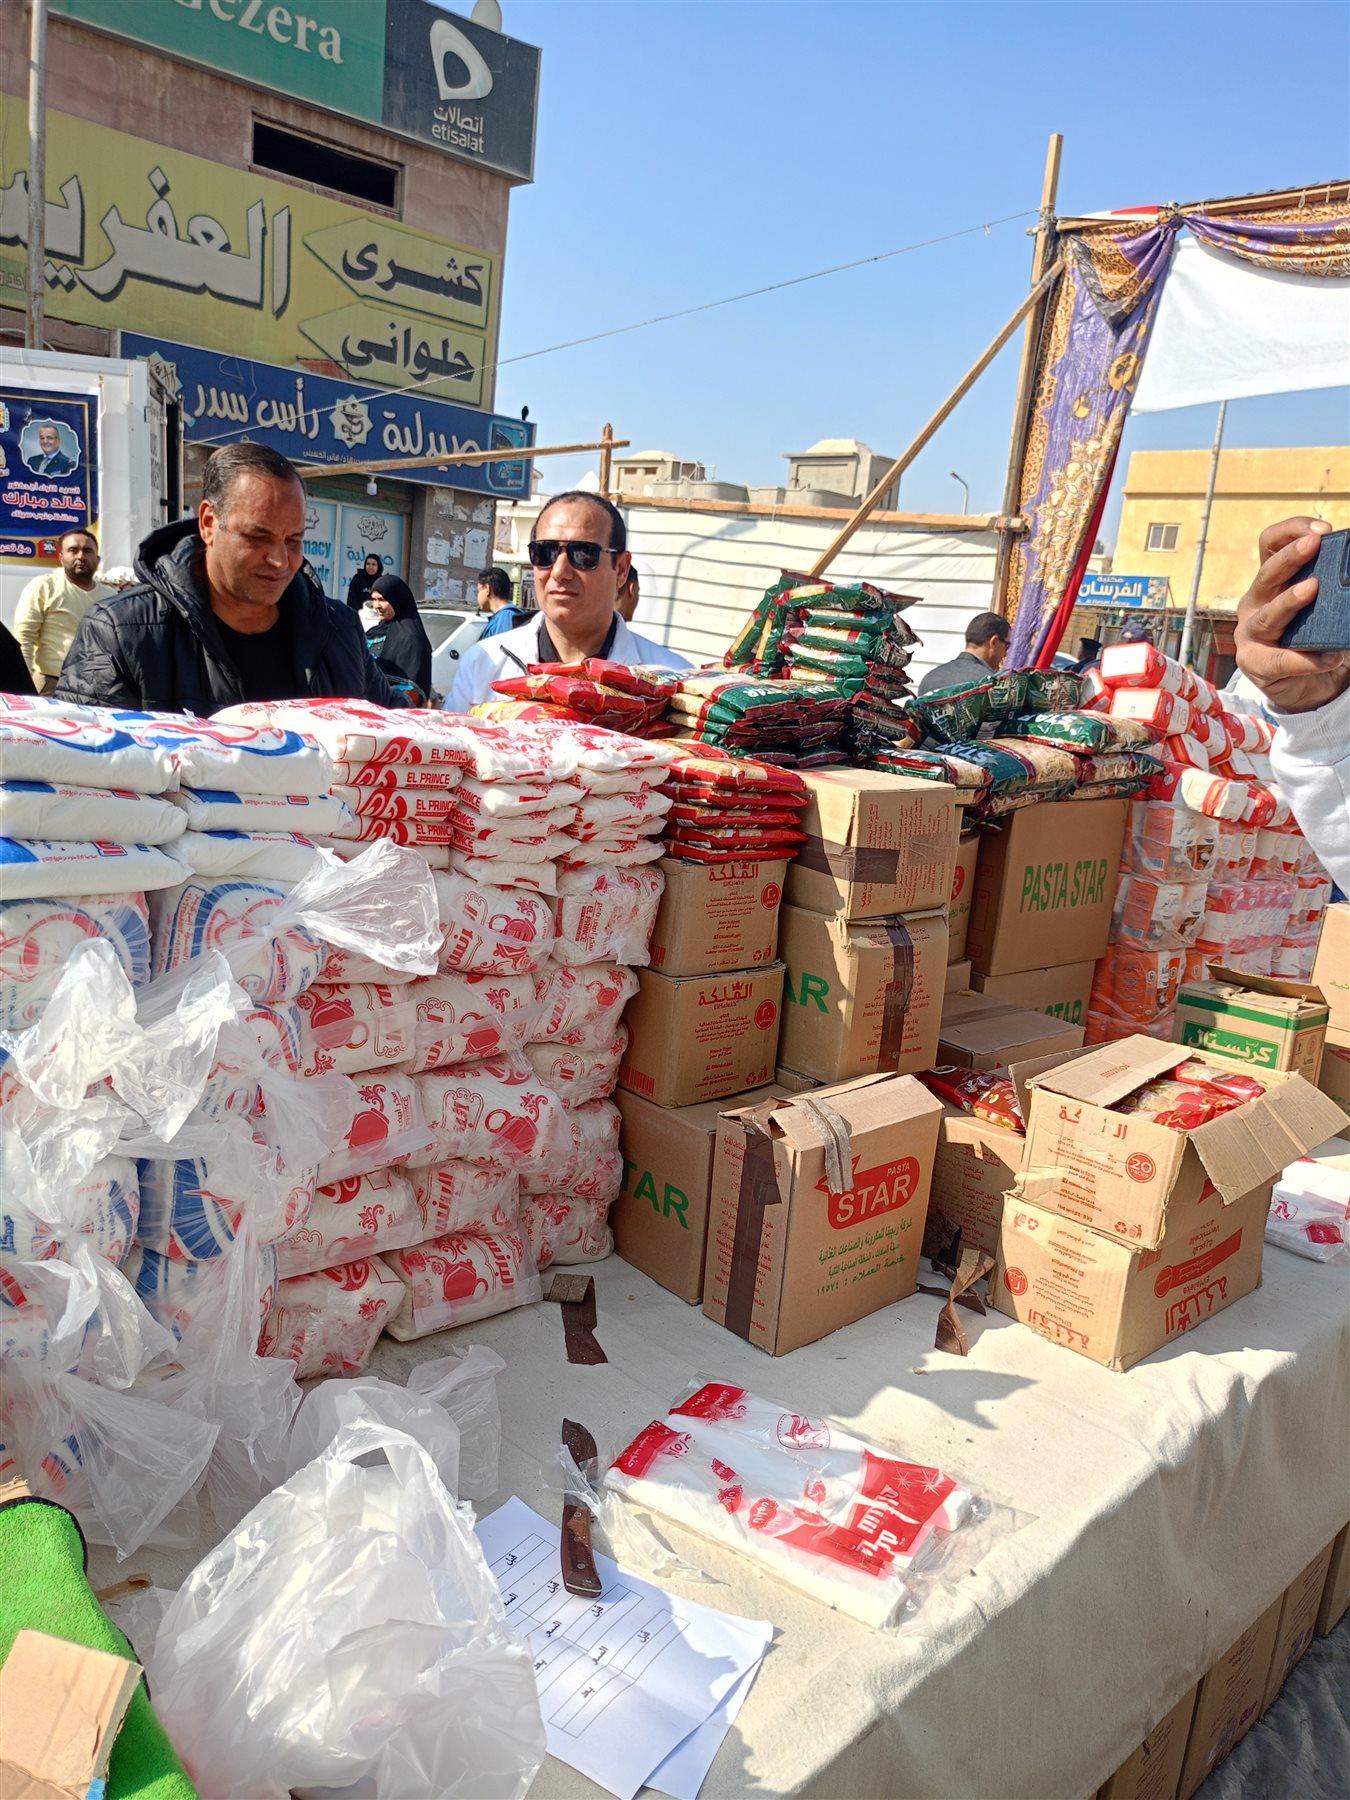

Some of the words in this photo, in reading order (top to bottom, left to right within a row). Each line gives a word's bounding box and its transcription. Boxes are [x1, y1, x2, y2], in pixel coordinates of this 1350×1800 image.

[175, 0, 344, 64] ezera
[433, 106, 484, 134] اتصالات
[431, 124, 485, 153] etisalat
[342, 243, 484, 306] كشرى
[194, 384, 249, 423] سدر
[256, 377, 319, 439] رأس
[1, 490, 49, 509] مبارك
[50, 494, 86, 509] خالد
[1079, 582, 1142, 600] الفرسان
[431, 749, 442, 760] EL
[935, 742, 994, 764] STAR
[407, 772, 418, 783] EL
[420, 772, 450, 784] PRINCE
[416, 799, 426, 810] EL
[456, 787, 481, 807] PRINCE
[416, 824, 426, 834] EL
[709, 863, 759, 882] الملكة
[1019, 862, 1069, 913] PASTA
[1070, 859, 1108, 908] STAR
[698, 982, 753, 1006] الملكة
[887, 1162, 911, 1177] PASTA
[1129, 1157, 1152, 1175] 20
[621, 1157, 690, 1230] TAR
[836, 1174, 911, 1223] STAR
[1166, 1276, 1227, 1335] الملكة
[505, 1553, 518, 1566] قبل
[547, 1580, 560, 1594] قبل
[504, 1592, 518, 1607] السع
[591, 1603, 604, 1618] قبل
[546, 1620, 563, 1638] السعر
[637, 1629, 651, 1644] قبل
[592, 1645, 609, 1665] السعر
[581, 1687, 595, 1699] بعد
